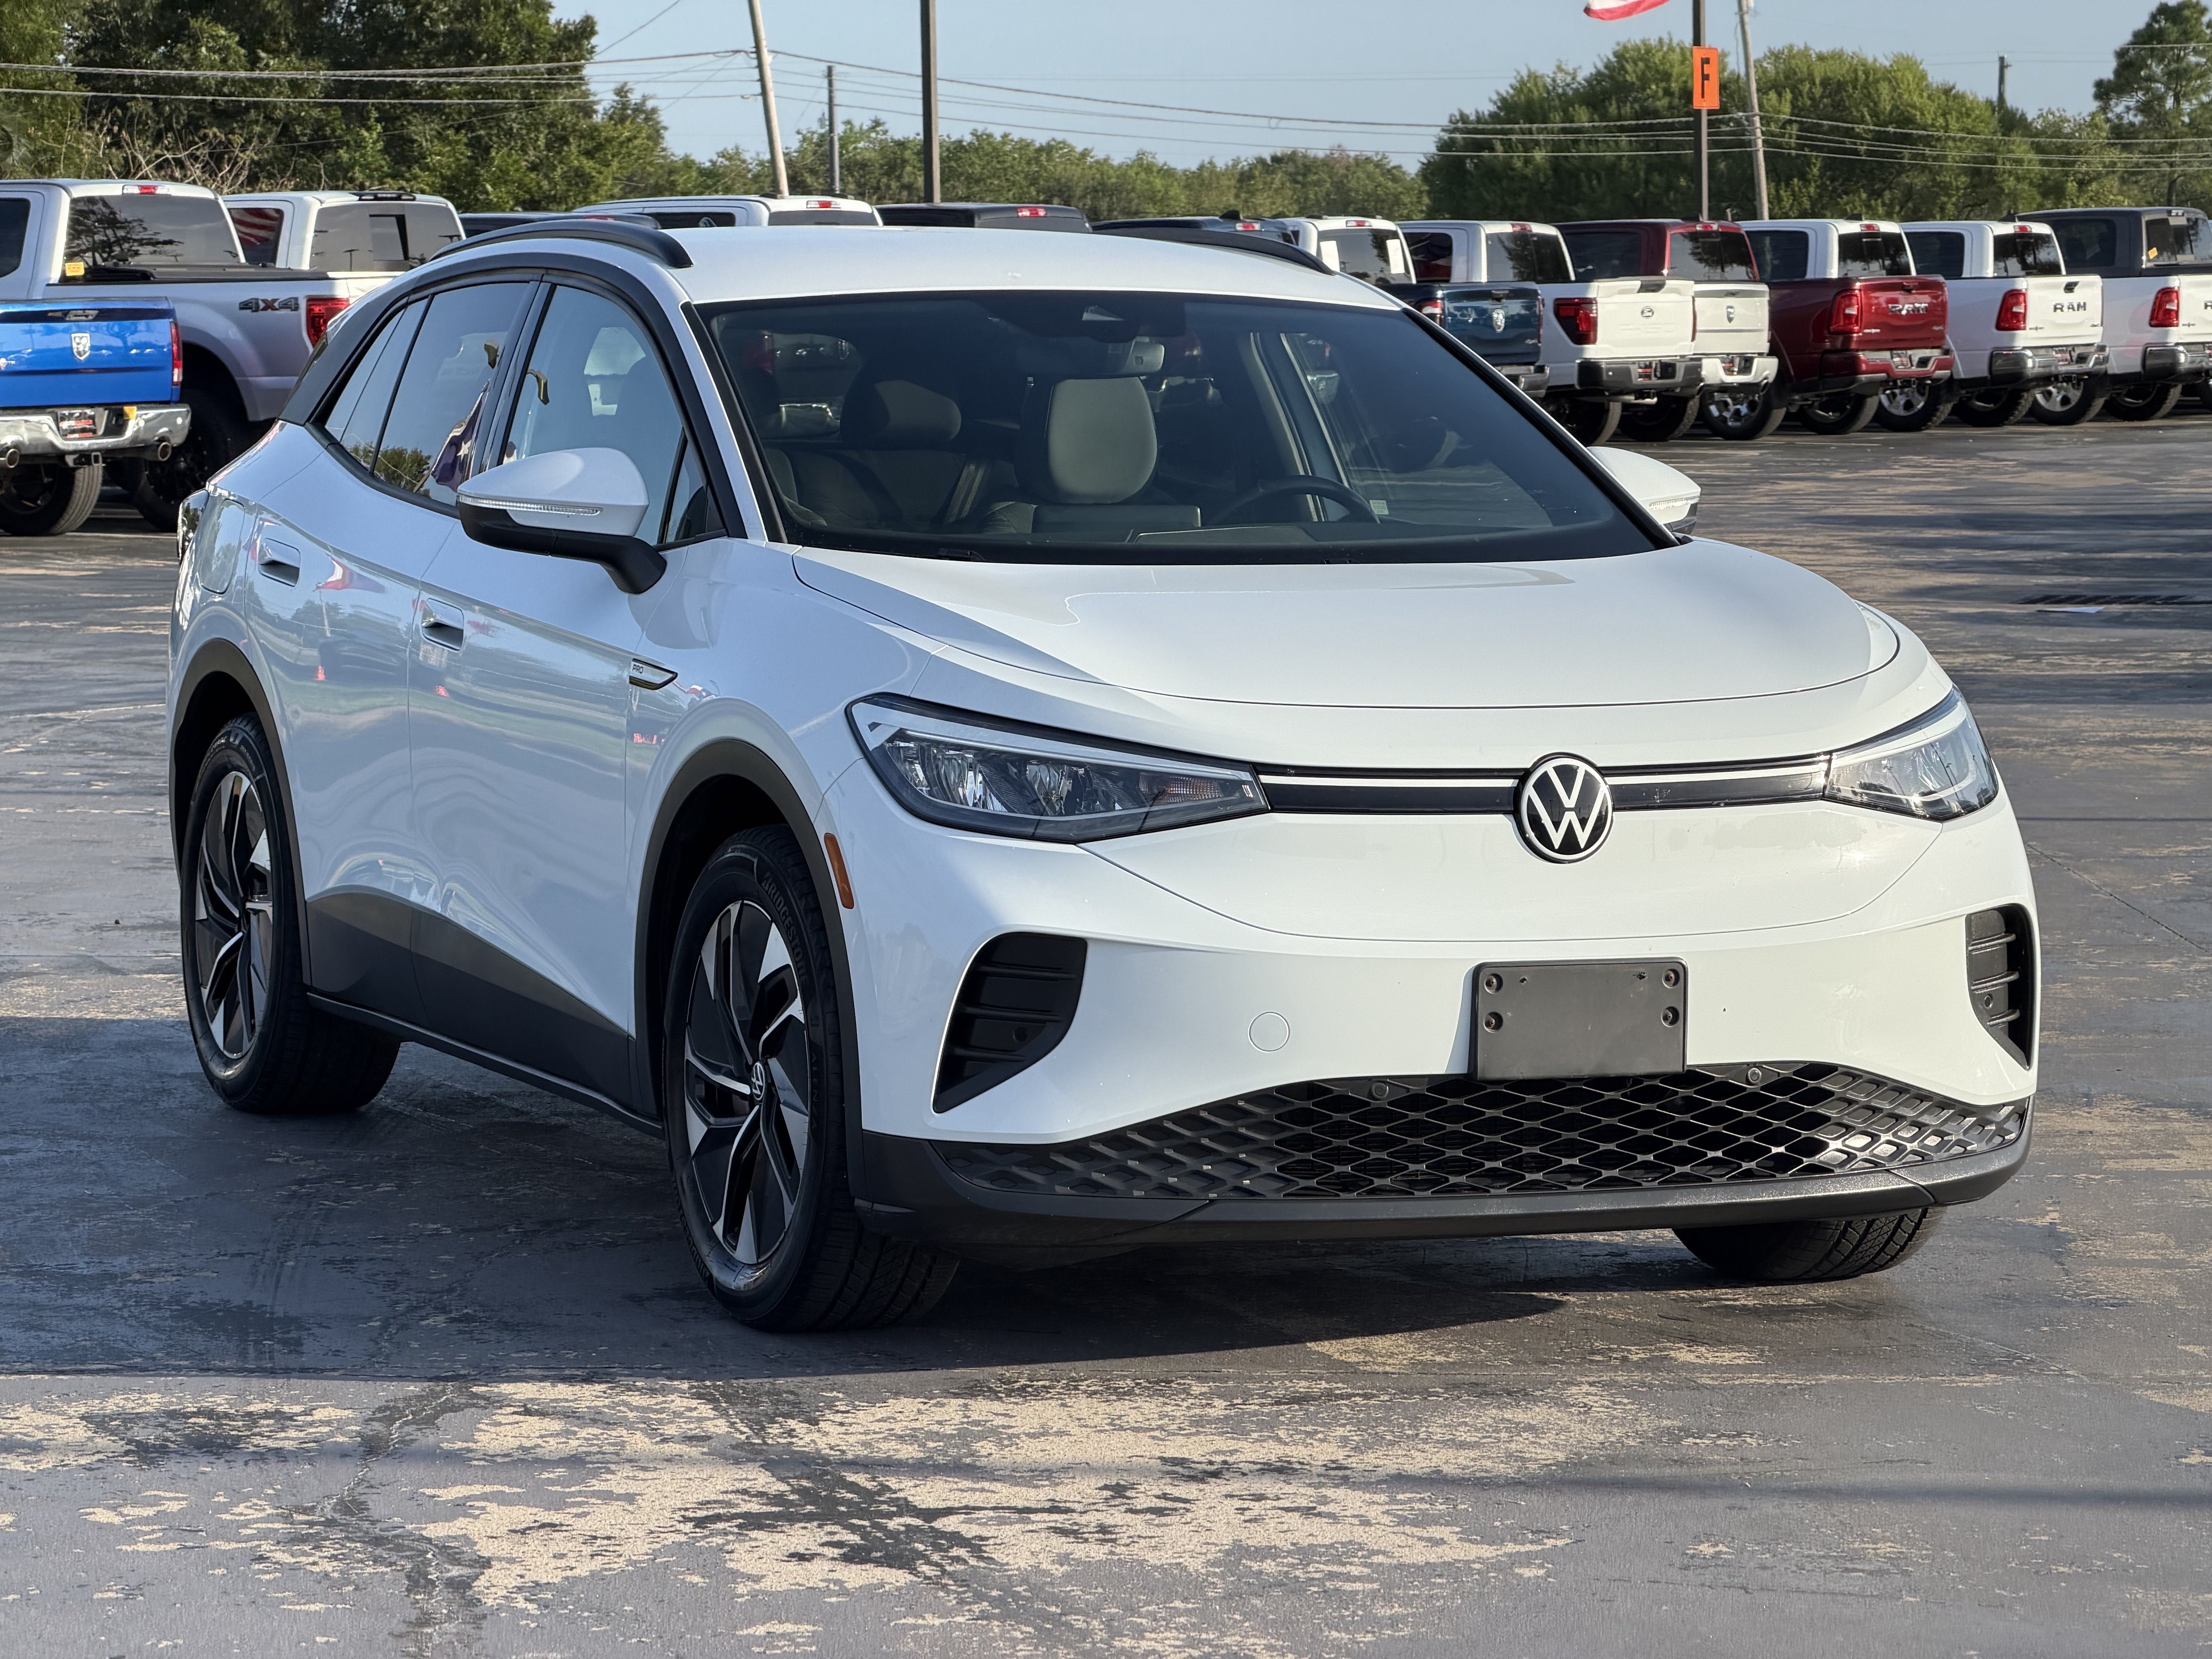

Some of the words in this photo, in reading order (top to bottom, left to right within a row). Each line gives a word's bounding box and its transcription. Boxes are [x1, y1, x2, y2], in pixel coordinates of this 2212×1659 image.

[1701, 57, 1710, 98] F
[2053, 302, 2087, 312] RAM
[632, 664, 644, 674] PRO
[761, 871, 809, 985] BRIDGESTONE
